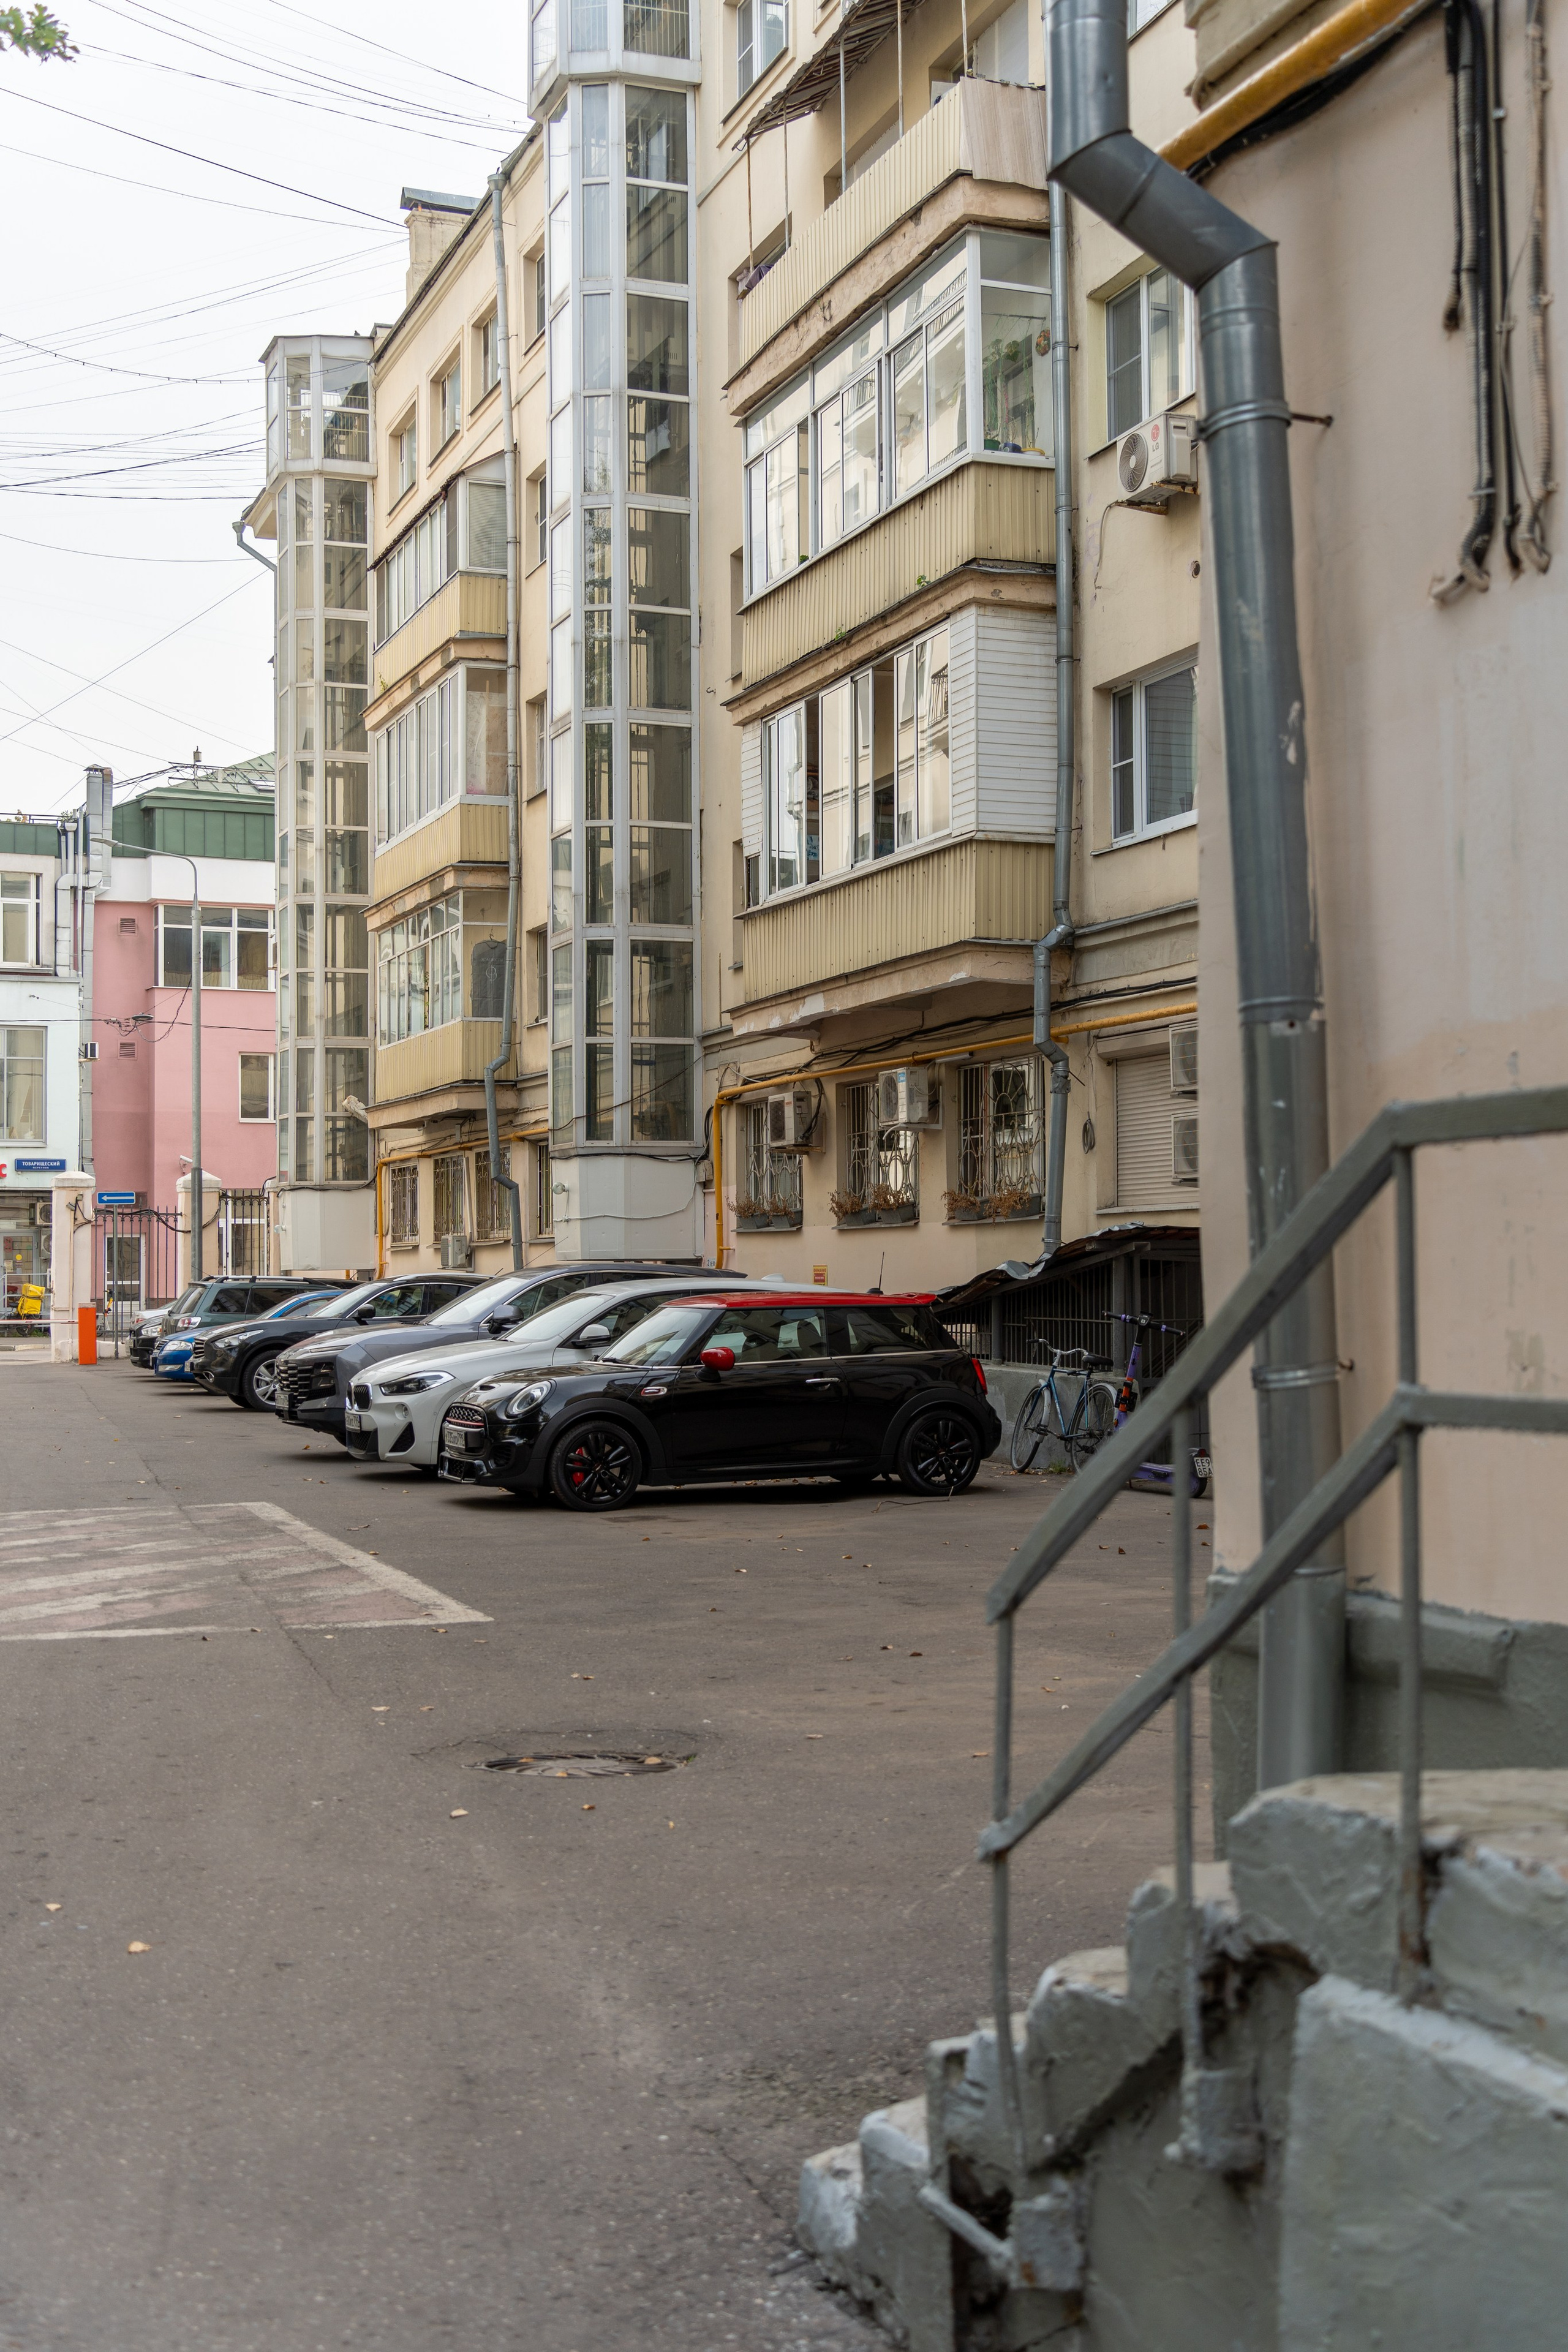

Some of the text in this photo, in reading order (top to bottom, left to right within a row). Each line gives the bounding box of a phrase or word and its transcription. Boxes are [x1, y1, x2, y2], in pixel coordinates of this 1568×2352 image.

[1152, 442, 1159, 452] LG
[1195, 1458, 1210, 1467] EE9
[1197, 1467, 1214, 1476] 85A
